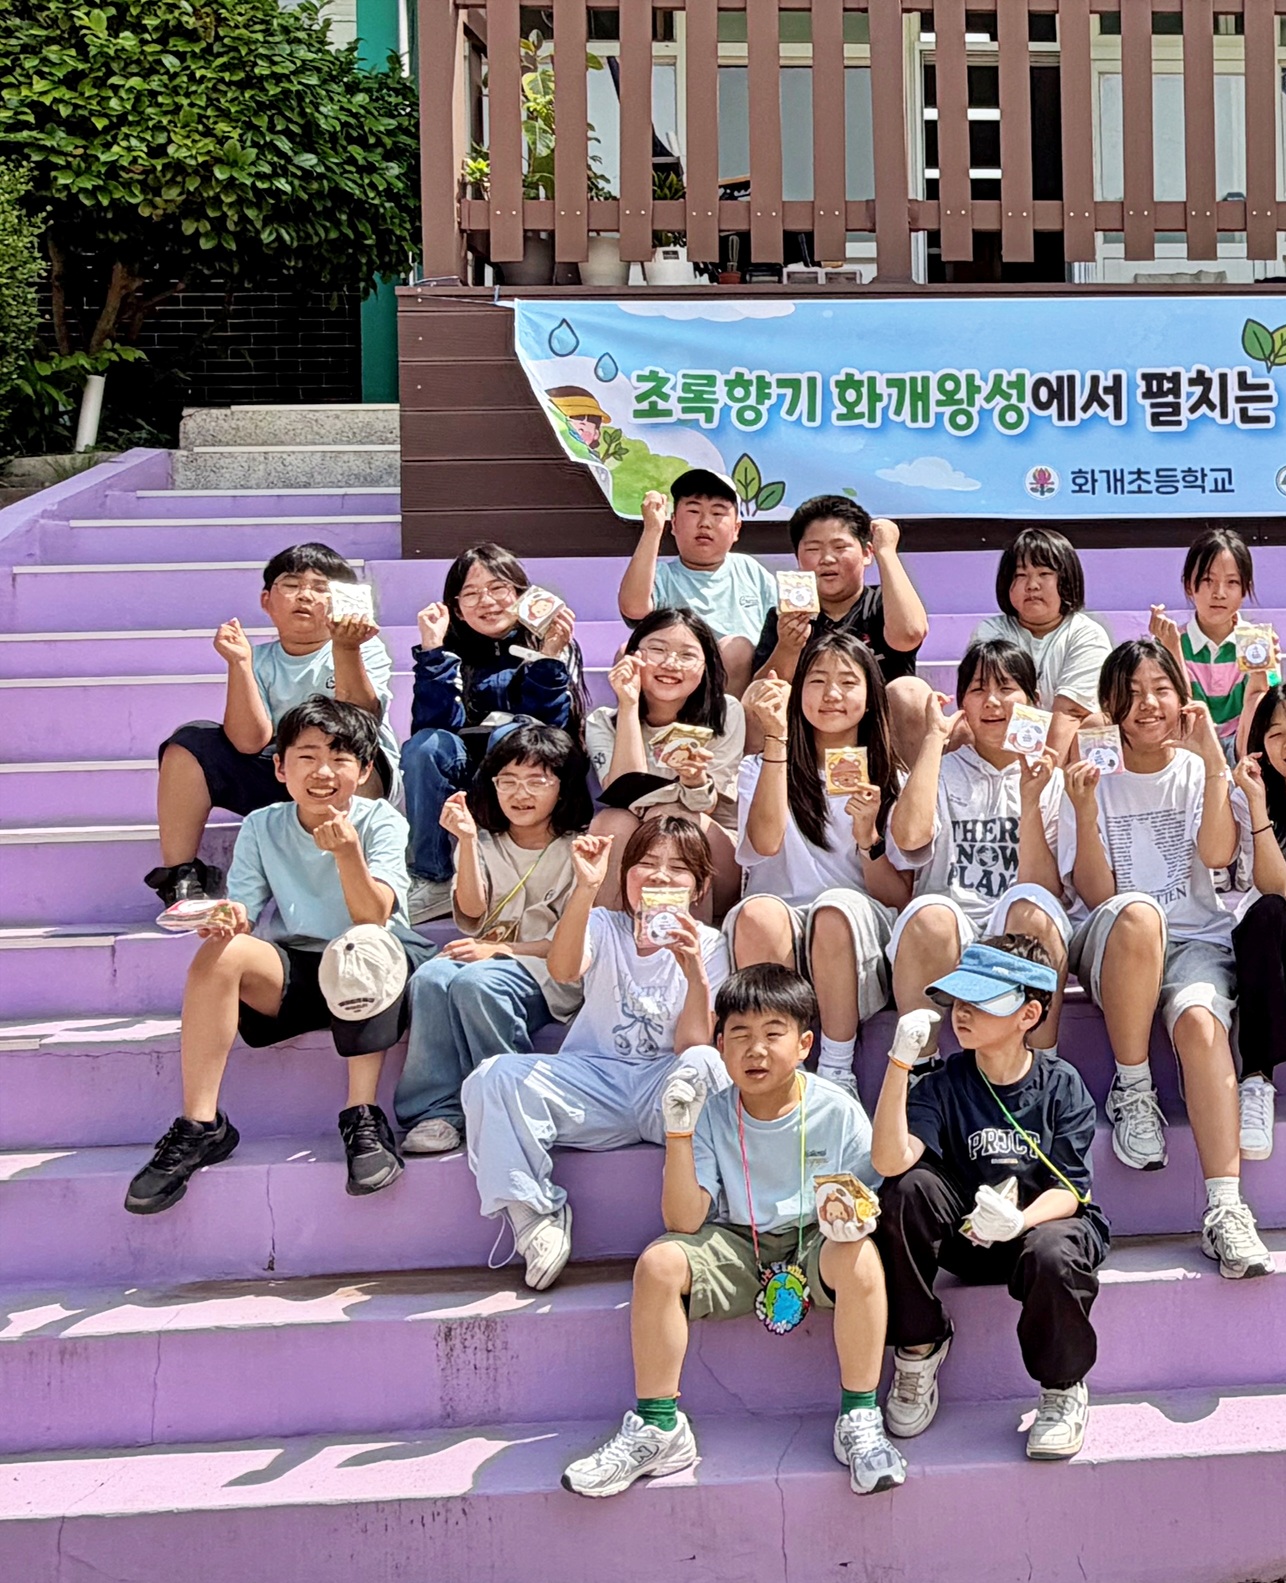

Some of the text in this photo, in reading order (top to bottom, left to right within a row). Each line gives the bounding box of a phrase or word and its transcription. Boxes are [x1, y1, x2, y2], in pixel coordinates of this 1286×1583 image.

[631, 368, 819, 428] 초록향기
[833, 371, 1124, 432] 화개왕성에서
[1139, 367, 1275, 428] 펼치는
[1070, 466, 1236, 496] 화개초등학교
[951, 816, 1021, 844] THER
[967, 1127, 1041, 1161] PRJCT
